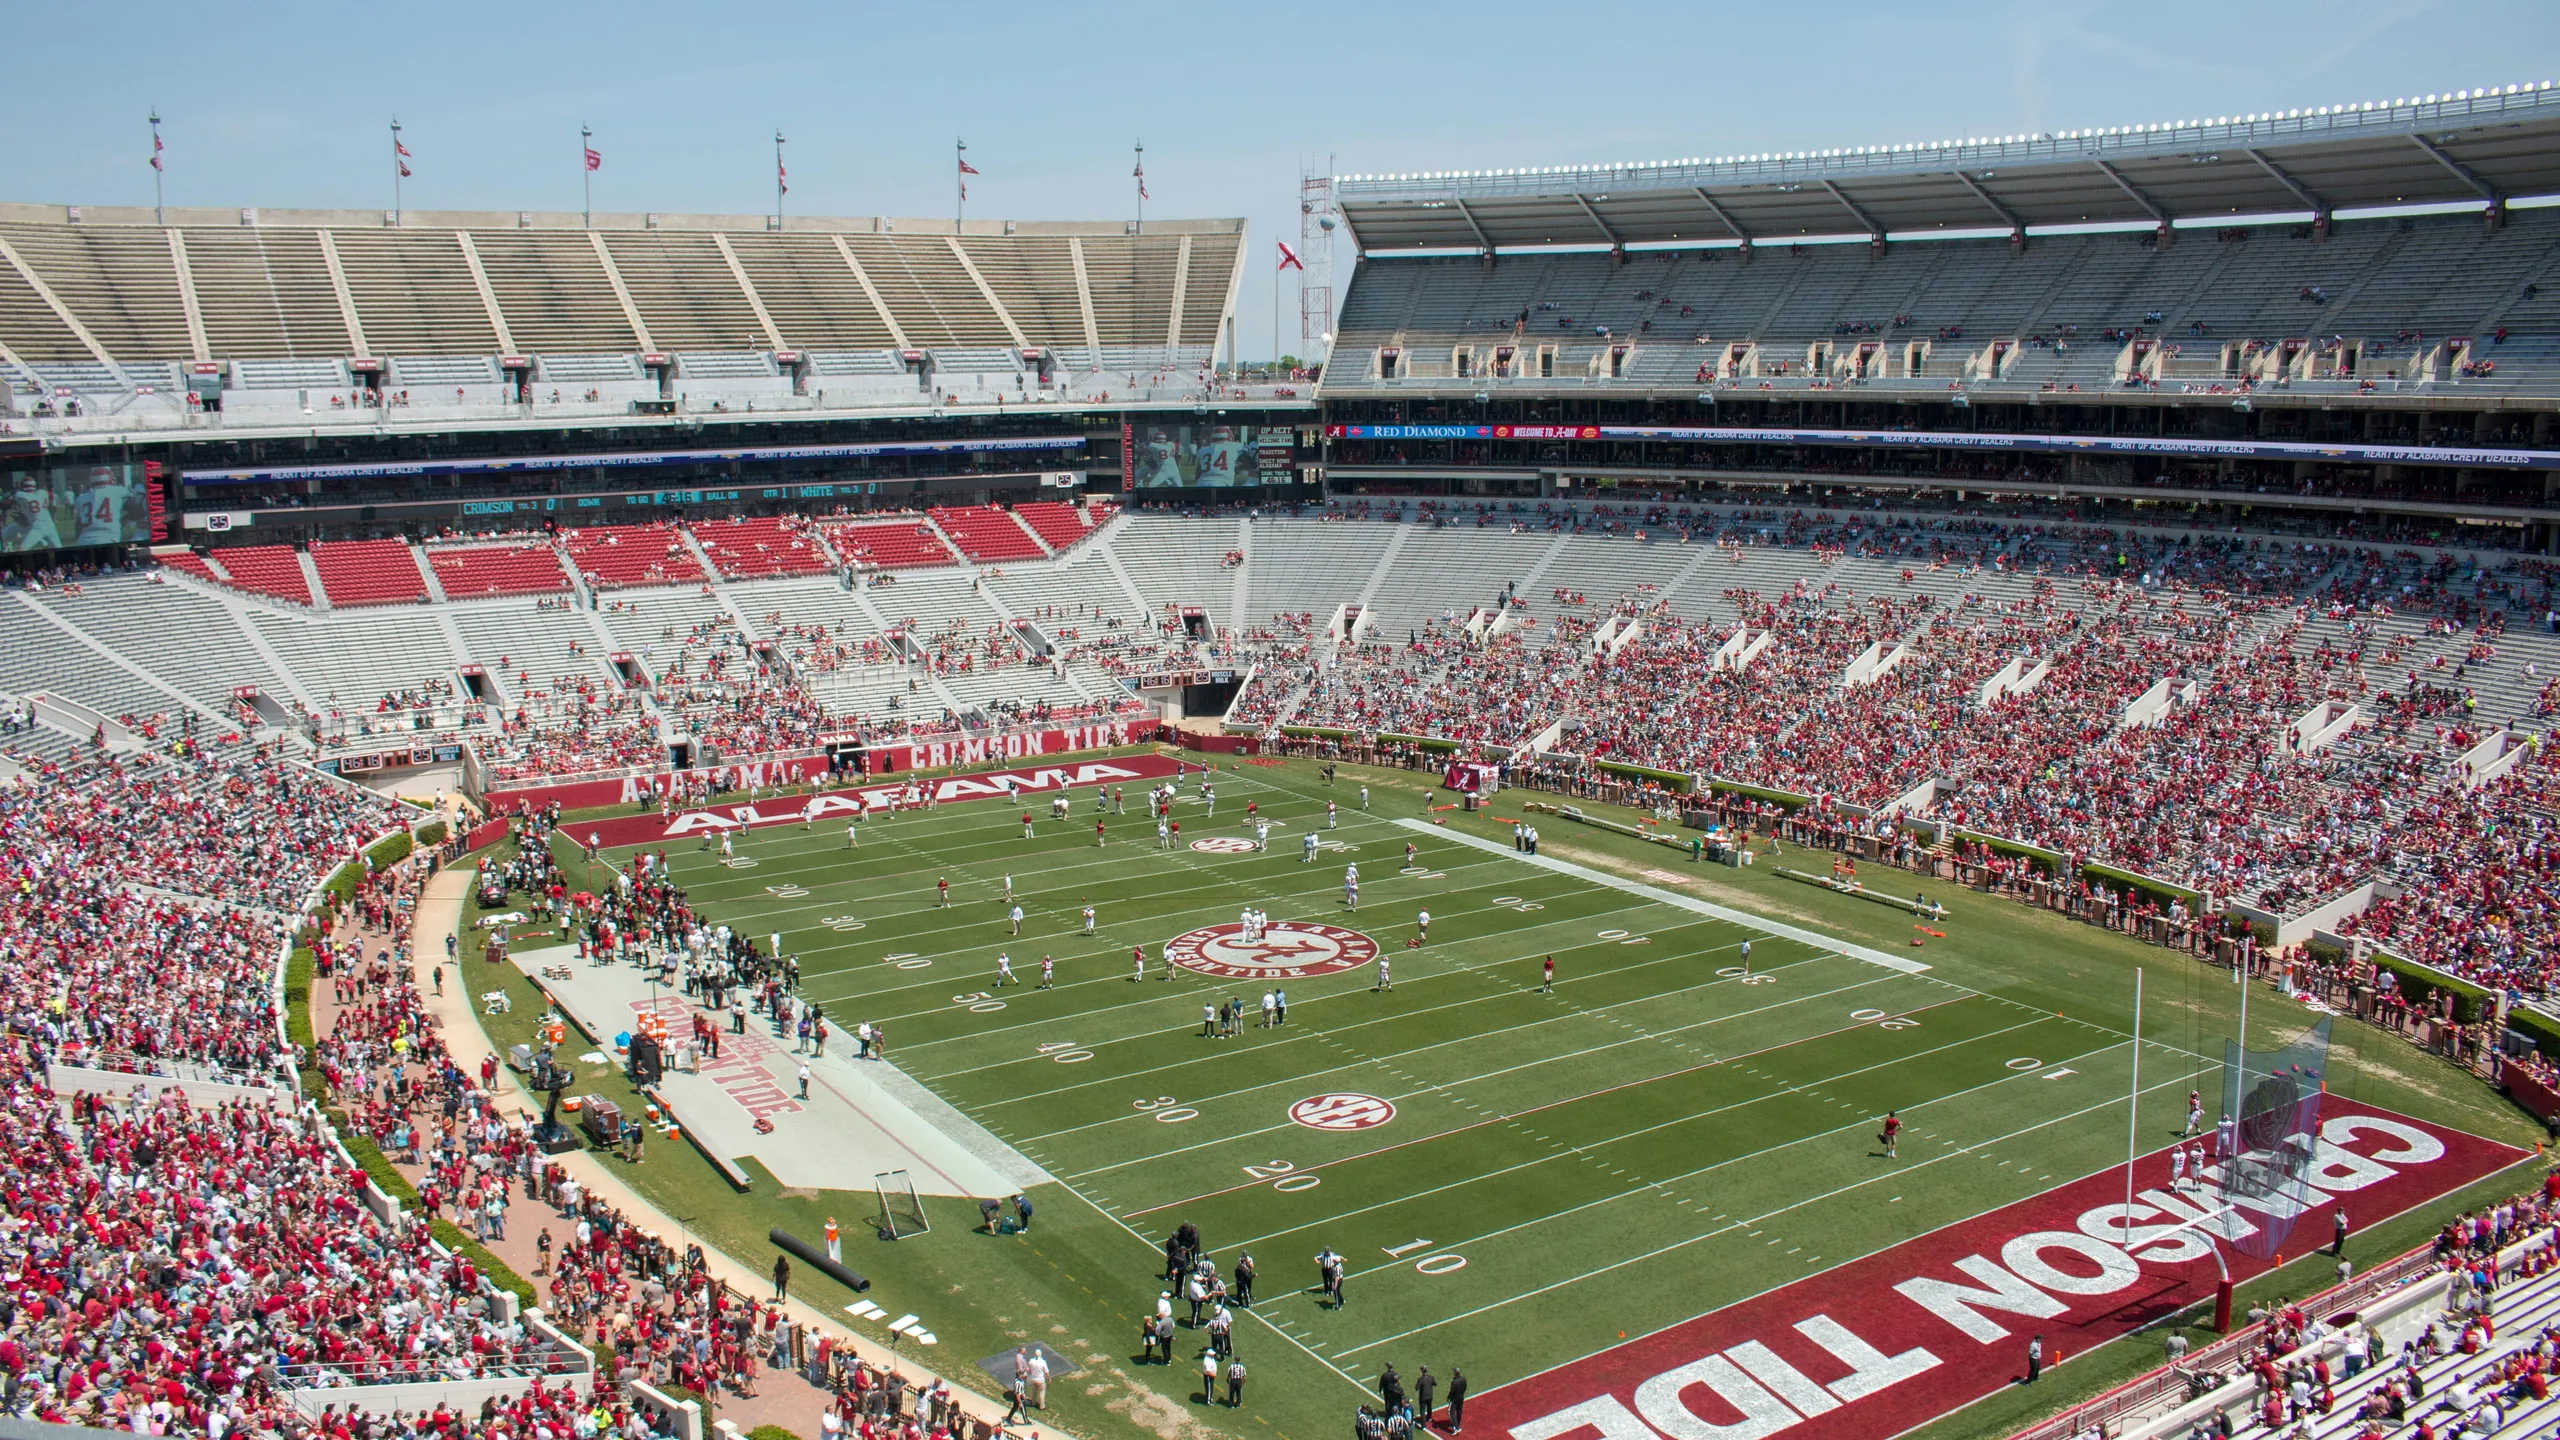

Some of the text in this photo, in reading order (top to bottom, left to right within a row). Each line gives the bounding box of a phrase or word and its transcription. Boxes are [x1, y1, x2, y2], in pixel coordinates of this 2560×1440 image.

[1374, 426, 1399, 437] RED
[1404, 426, 1466, 437] DIAMOND
[1513, 427, 1544, 437] WELCOME
[1544, 428, 1553, 437] TO
[1671, 431, 1794, 441] HEART OF ALABAMA CHEVY DEALERS
[1028, 441, 1049, 449] CHEVY
[1050, 440, 1078, 448] DEALERS
[1883, 435, 1907, 443] HEART
[1918, 436, 1954, 444] ALABAMA
[1955, 437, 1980, 445] CHEVY
[1980, 438, 2014, 446] DEALERS
[755, 447, 880, 459] HEART OF ALABAMA CHEVY DEALERS
[2111, 442, 2255, 454] HEART OF ALABAMA CHEVY DEALERS
[524, 456, 663, 469] HEART OF ALABAMA CHEVY DEALERS
[1201, 451, 1228, 473] 34
[2363, 450, 2530, 464] HEART OF ALABAMA CHEVY DEALERS
[270, 466, 424, 480] HEART OF ALABAMA CHEVY DEALERS
[1058, 475, 1071, 486] 25
[706, 491, 739, 501] BALL ON
[763, 489, 788, 499] QTR 1
[800, 486, 833, 498] WHITE
[853, 485, 859, 494] 3
[867, 483, 876, 494] 0
[145, 460, 168, 542] ALABAMA
[578, 498, 600, 508] DOWN
[626, 495, 649, 505] TO GO
[661, 492, 693, 504] 46:16
[81, 498, 113, 527] 34
[463, 501, 514, 515] CRIMSON
[531, 501, 538, 510] 3
[546, 498, 555, 511] 0
[211, 516, 228, 528] 25
[1143, 675, 1170, 686] 46:16
[1196, 671, 1209, 682] 25
[819, 734, 856, 743] BAMA
[414, 750, 429, 762] 25
[434, 745, 461, 755] MUSCLE
[344, 755, 378, 769] 46:16
[439, 753, 457, 762] MILK
[765, 884, 810, 898] 20
[1492, 896, 1545, 913] 50
[821, 915, 866, 932] 30
[1596, 928, 1652, 945] 40
[1250, 922, 1371, 968] LABAMA
[882, 953, 933, 970] 40
[1226, 966, 1306, 978] TIDE
[1715, 966, 1777, 986] 30
[952, 991, 1008, 1013] 50
[1849, 1008, 1922, 1031] 20
[1035, 1041, 1095, 1064] 40
[2004, 1057, 2080, 1081] 10
[709, 1064, 805, 1119] TIDE
[1132, 1096, 1200, 1124] 30
[1296, 1092, 1390, 1129] SEC
[1241, 1159, 1321, 1193] 20
[1892, 1114, 2446, 1345] CRIMSON
[1380, 1237, 1469, 1275] 10
